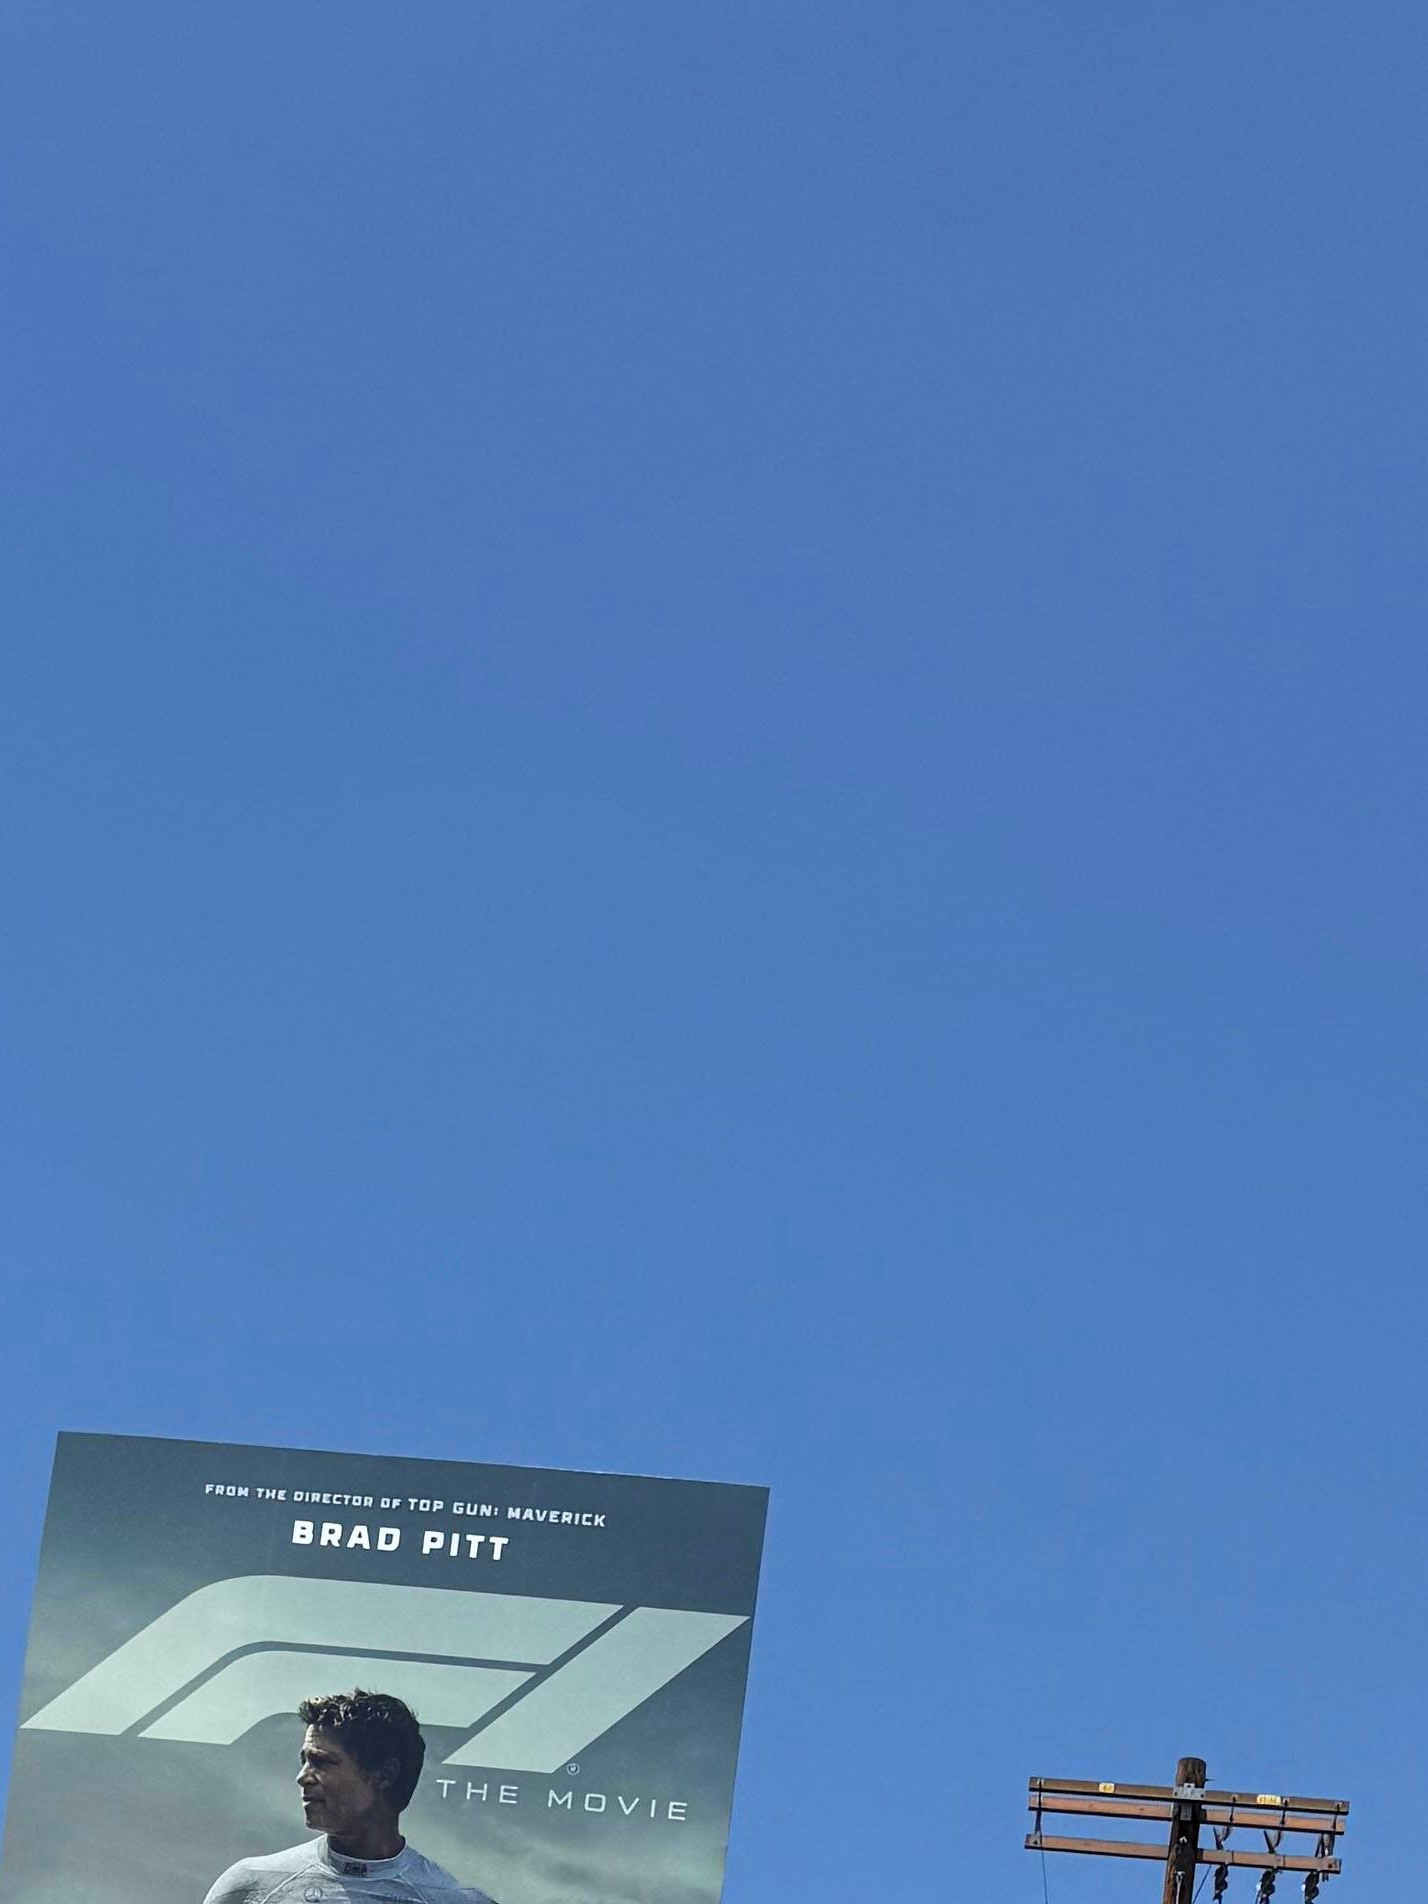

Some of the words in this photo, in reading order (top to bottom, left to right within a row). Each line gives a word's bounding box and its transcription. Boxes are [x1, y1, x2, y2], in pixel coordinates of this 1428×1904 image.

[205, 1484, 249, 1498] FROM
[257, 1487, 286, 1501] THE
[294, 1491, 373, 1508] DIRECTOR
[381, 1497, 402, 1510] OF
[408, 1498, 444, 1512] TOP
[453, 1502, 499, 1518] GUN:
[507, 1506, 607, 1528] MAVERICK
[291, 1520, 401, 1552] BRAD
[422, 1531, 509, 1561] PITT
[20, 1575, 750, 1774] F1
[436, 1779, 519, 1804] THE
[547, 1789, 688, 1821] MOVIE
